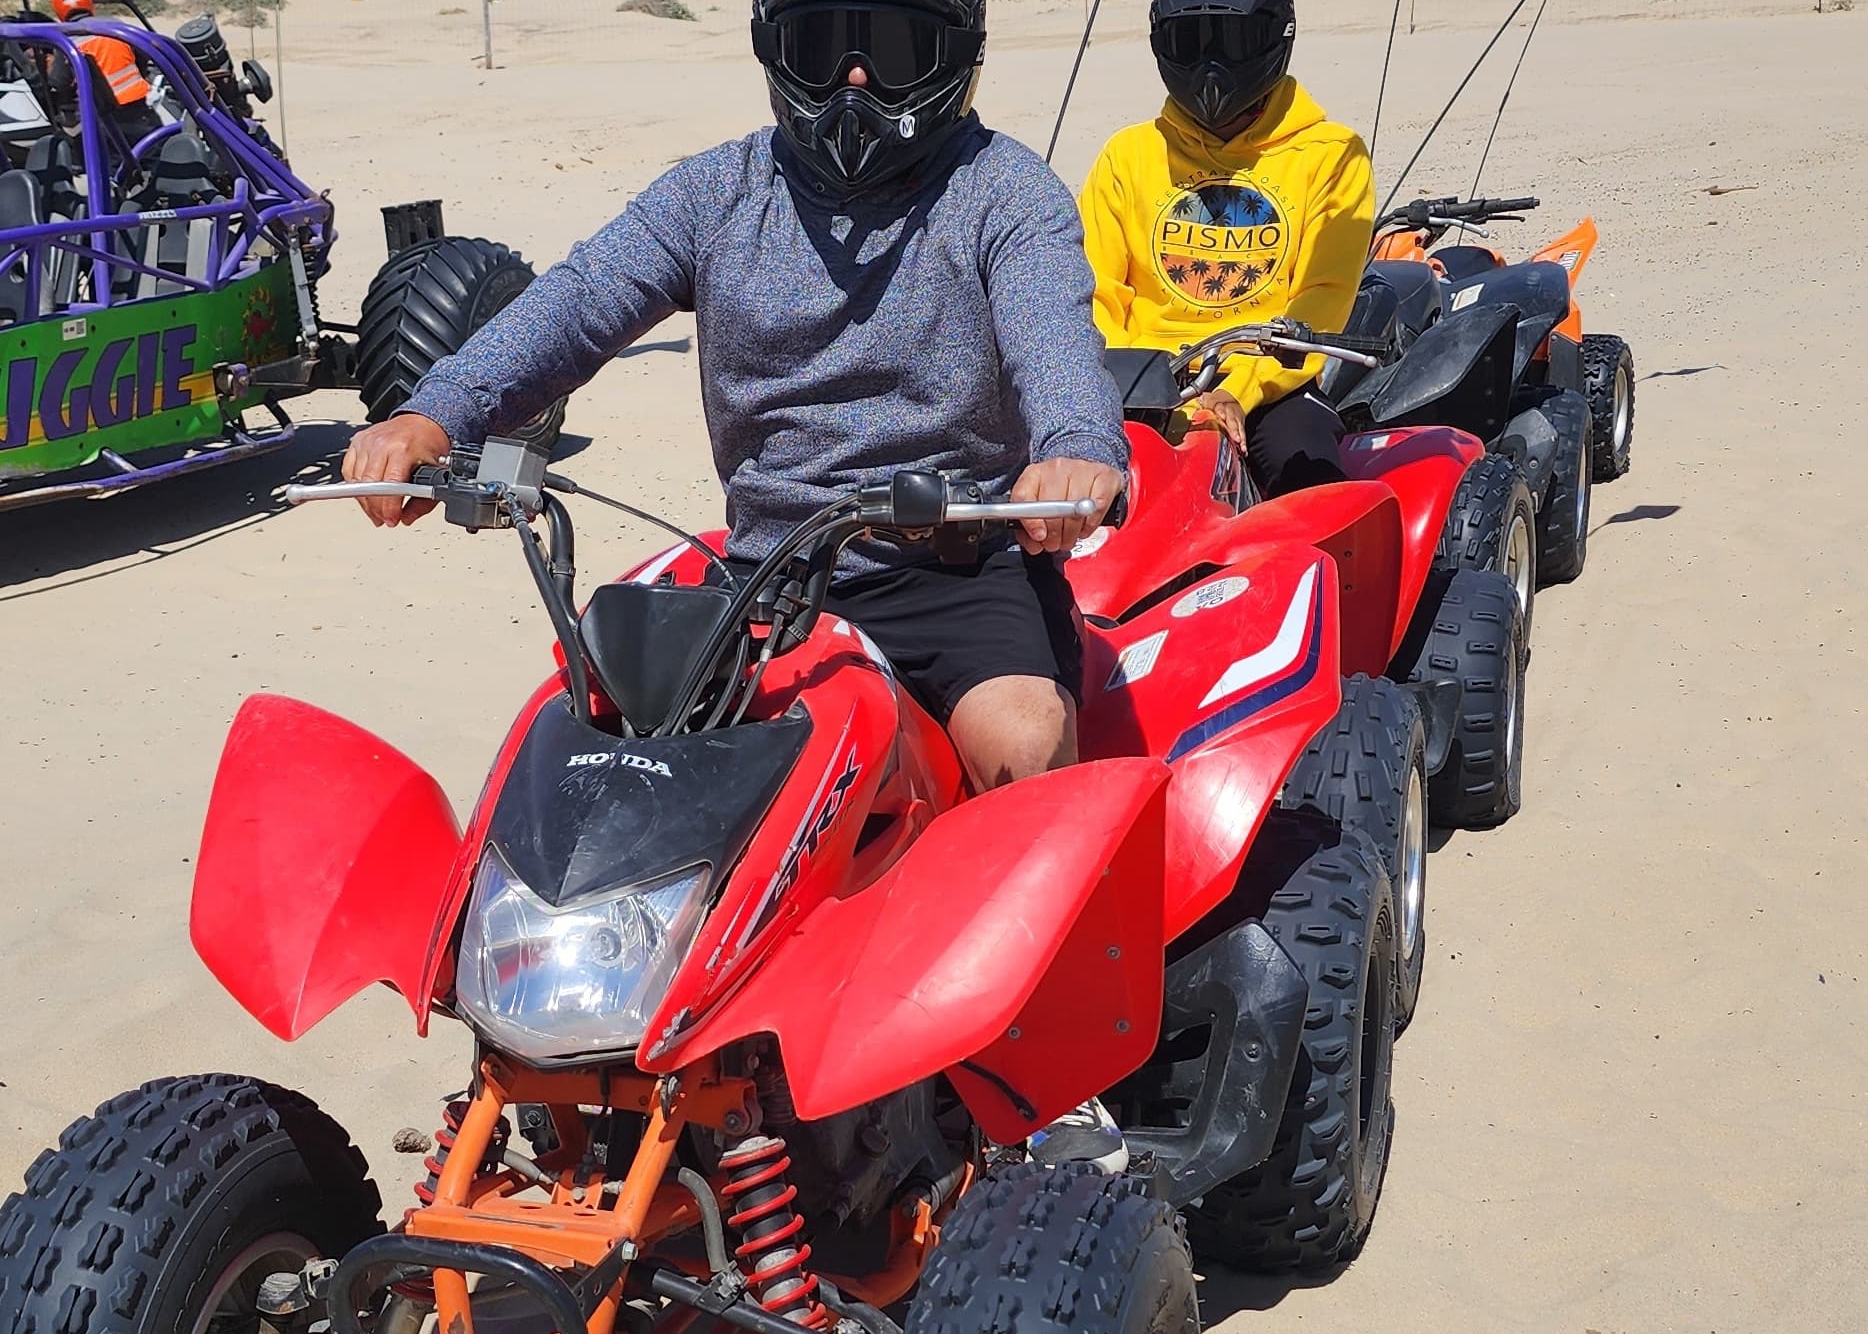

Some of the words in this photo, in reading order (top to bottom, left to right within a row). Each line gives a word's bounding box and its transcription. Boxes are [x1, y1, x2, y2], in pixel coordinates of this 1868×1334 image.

[1162, 222, 1281, 250] PISMO
[1151, 272, 1286, 319] CALIFORNIA
[566, 752, 673, 778] HONDA
